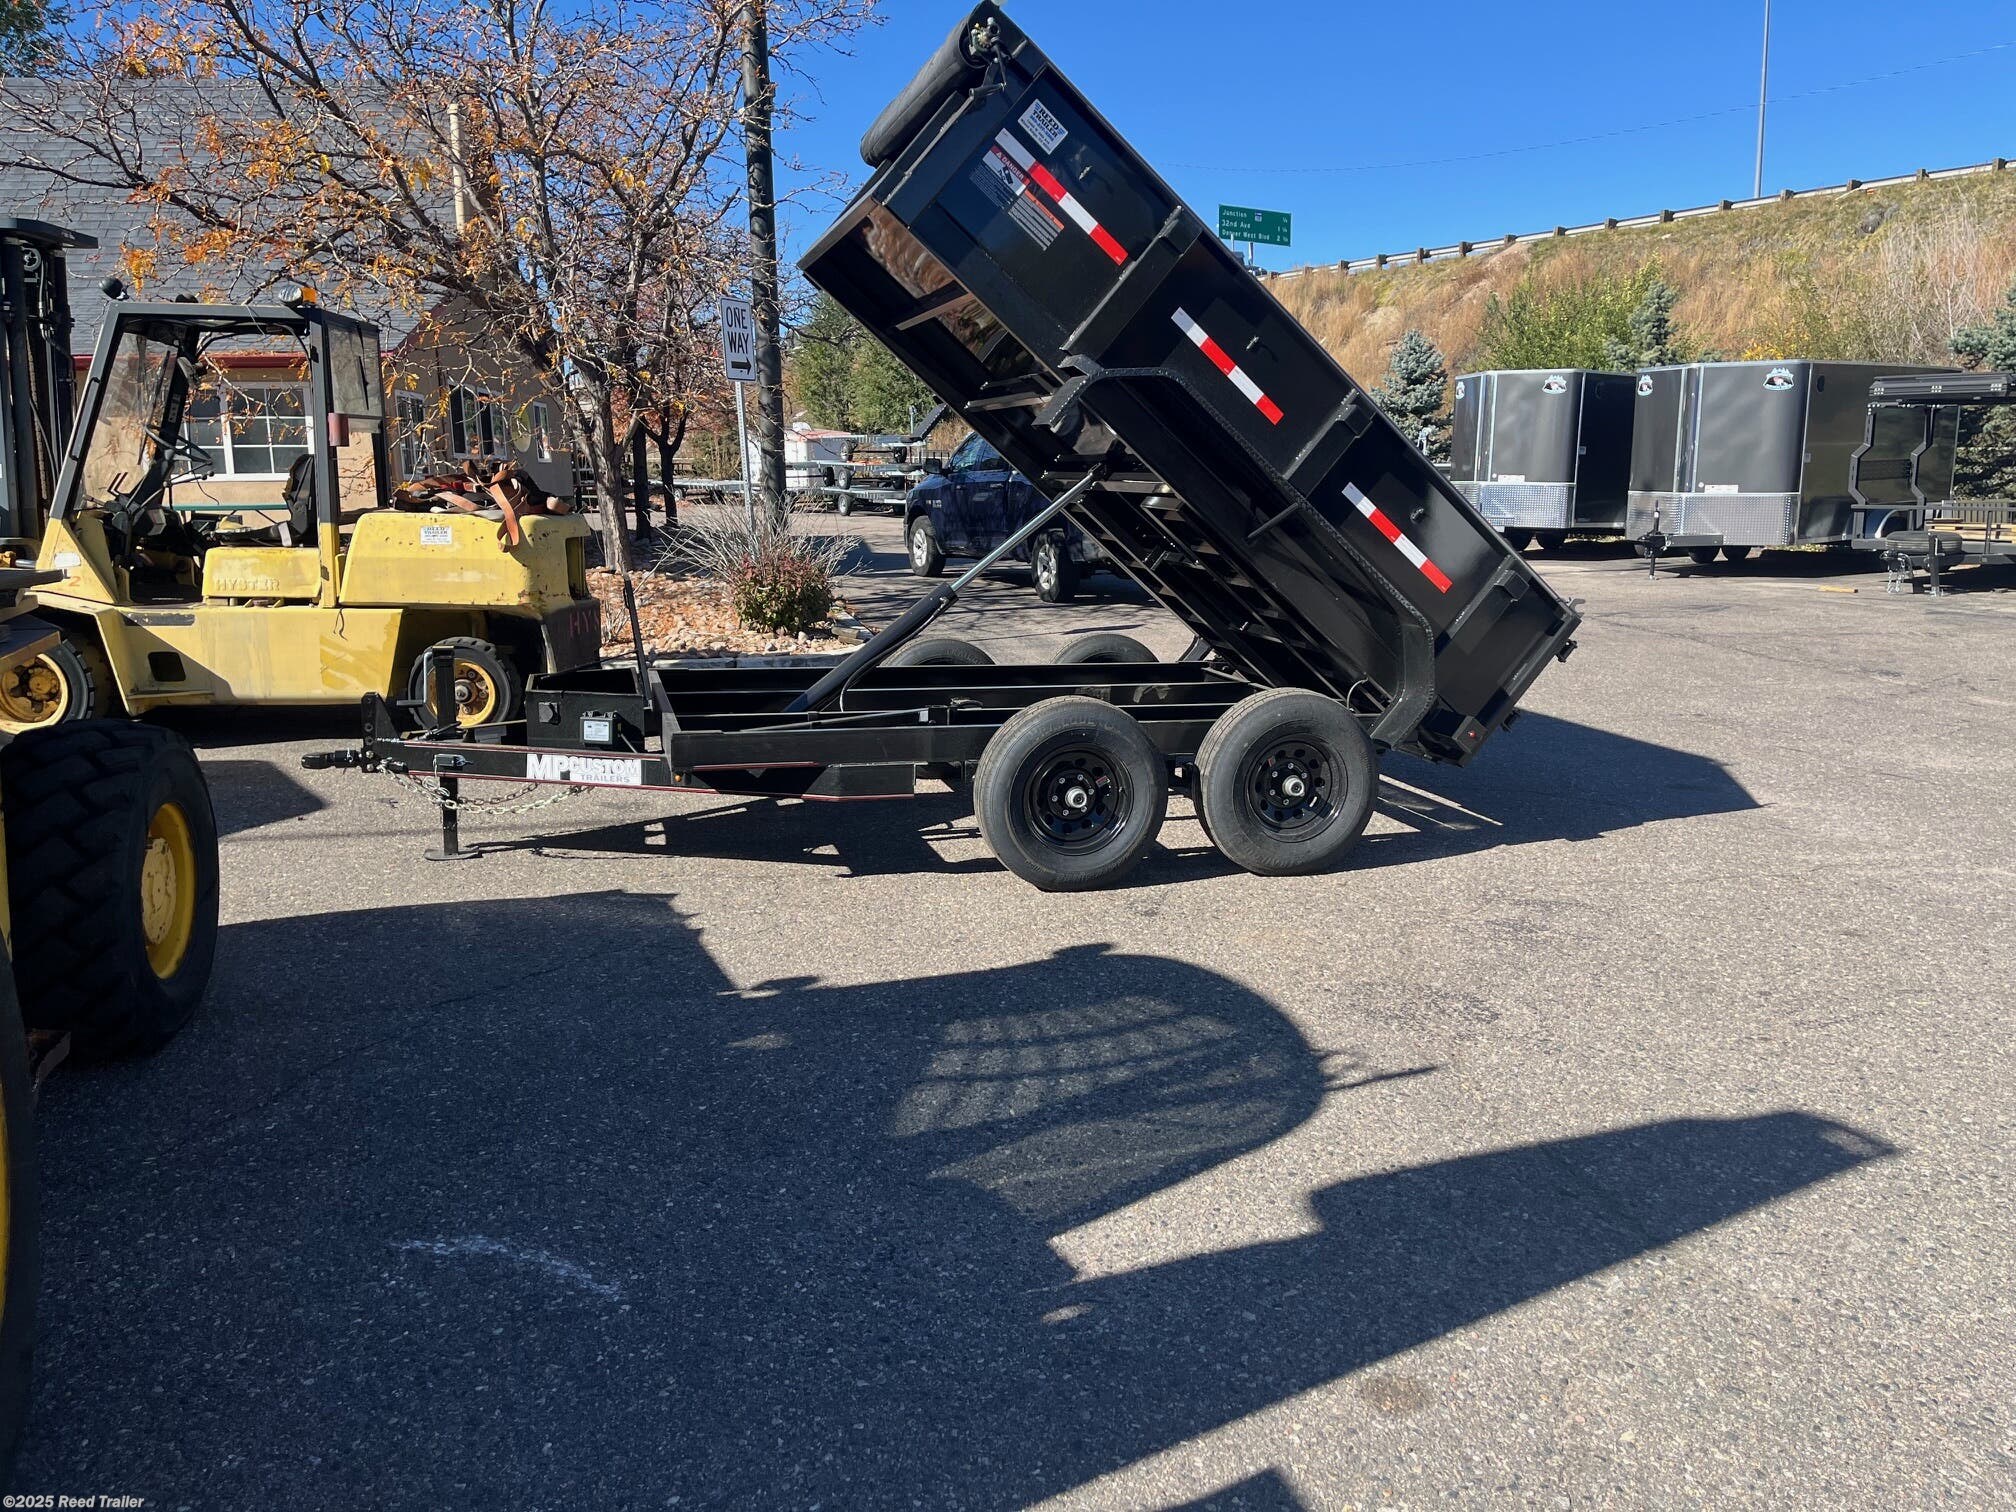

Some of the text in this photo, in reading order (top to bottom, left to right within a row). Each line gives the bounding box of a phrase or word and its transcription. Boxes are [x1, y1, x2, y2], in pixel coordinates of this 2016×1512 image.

[1033, 109, 1058, 138] TRAILER
[1001, 156, 1024, 180] DANGER
[1240, 221, 1251, 229] Ave
[726, 306, 747, 329] ONE
[727, 331, 749, 354] WAY
[215, 576, 280, 592] HYSTER
[526, 753, 642, 780] MP CUSTOM
[581, 773, 631, 784] TRAILERS
